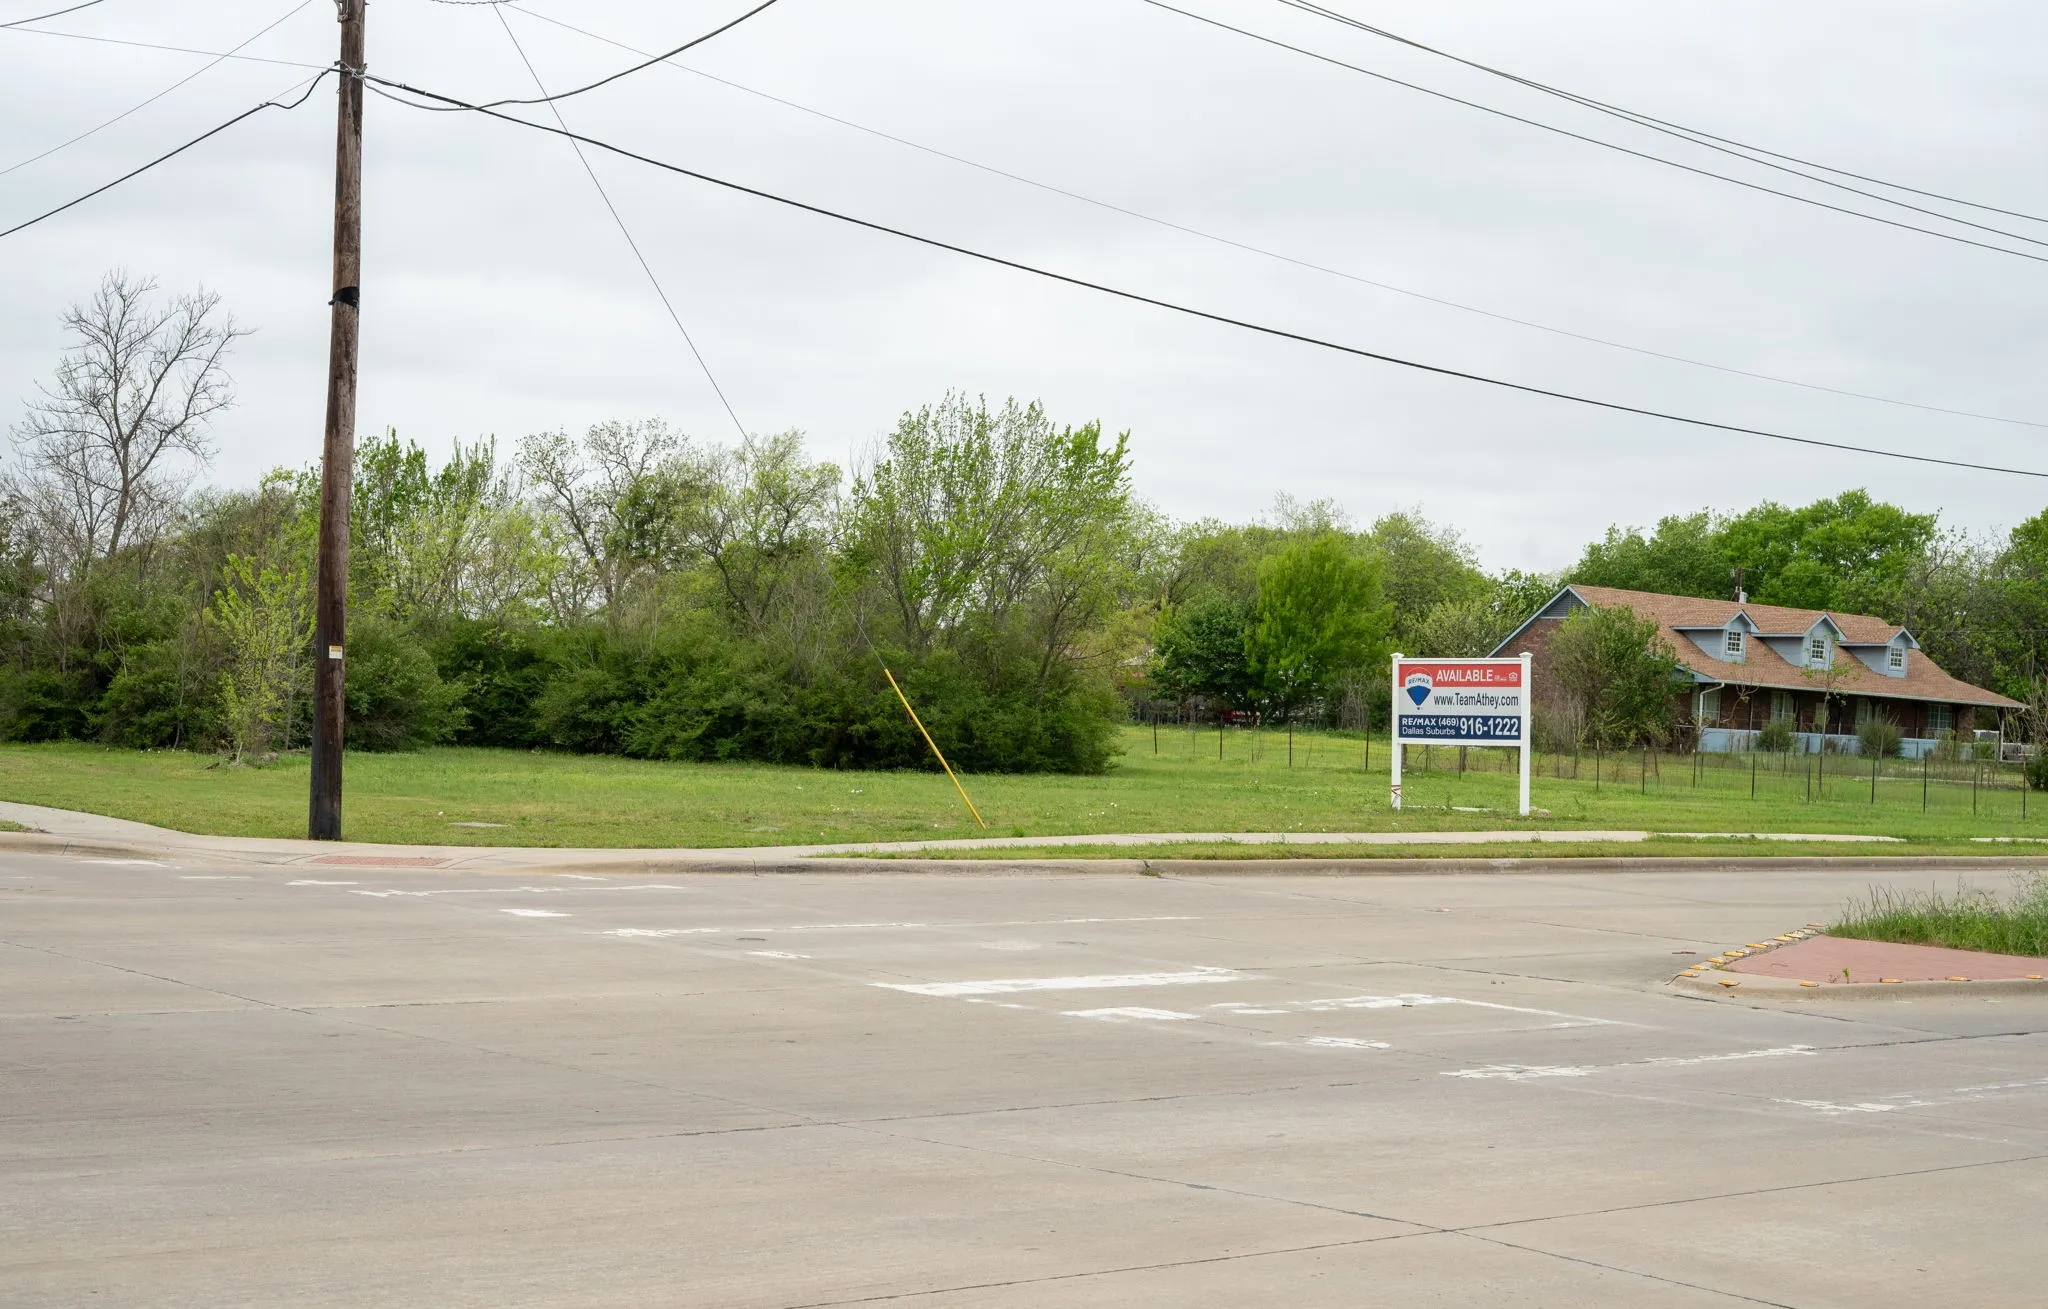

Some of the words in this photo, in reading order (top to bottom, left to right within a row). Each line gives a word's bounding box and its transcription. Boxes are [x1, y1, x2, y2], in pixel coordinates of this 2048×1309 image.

[1436, 669, 1493, 681] AVAILABLE
[1434, 693, 1518, 709] www.TeamAthey.com
[1402, 718, 1436, 726] RE/MAX
[1438, 717, 1459, 727] (469)
[1460, 717, 1519, 736] 916-1222
[1402, 727, 1424, 735] Dallas
[1426, 727, 1456, 735] Suburbs
